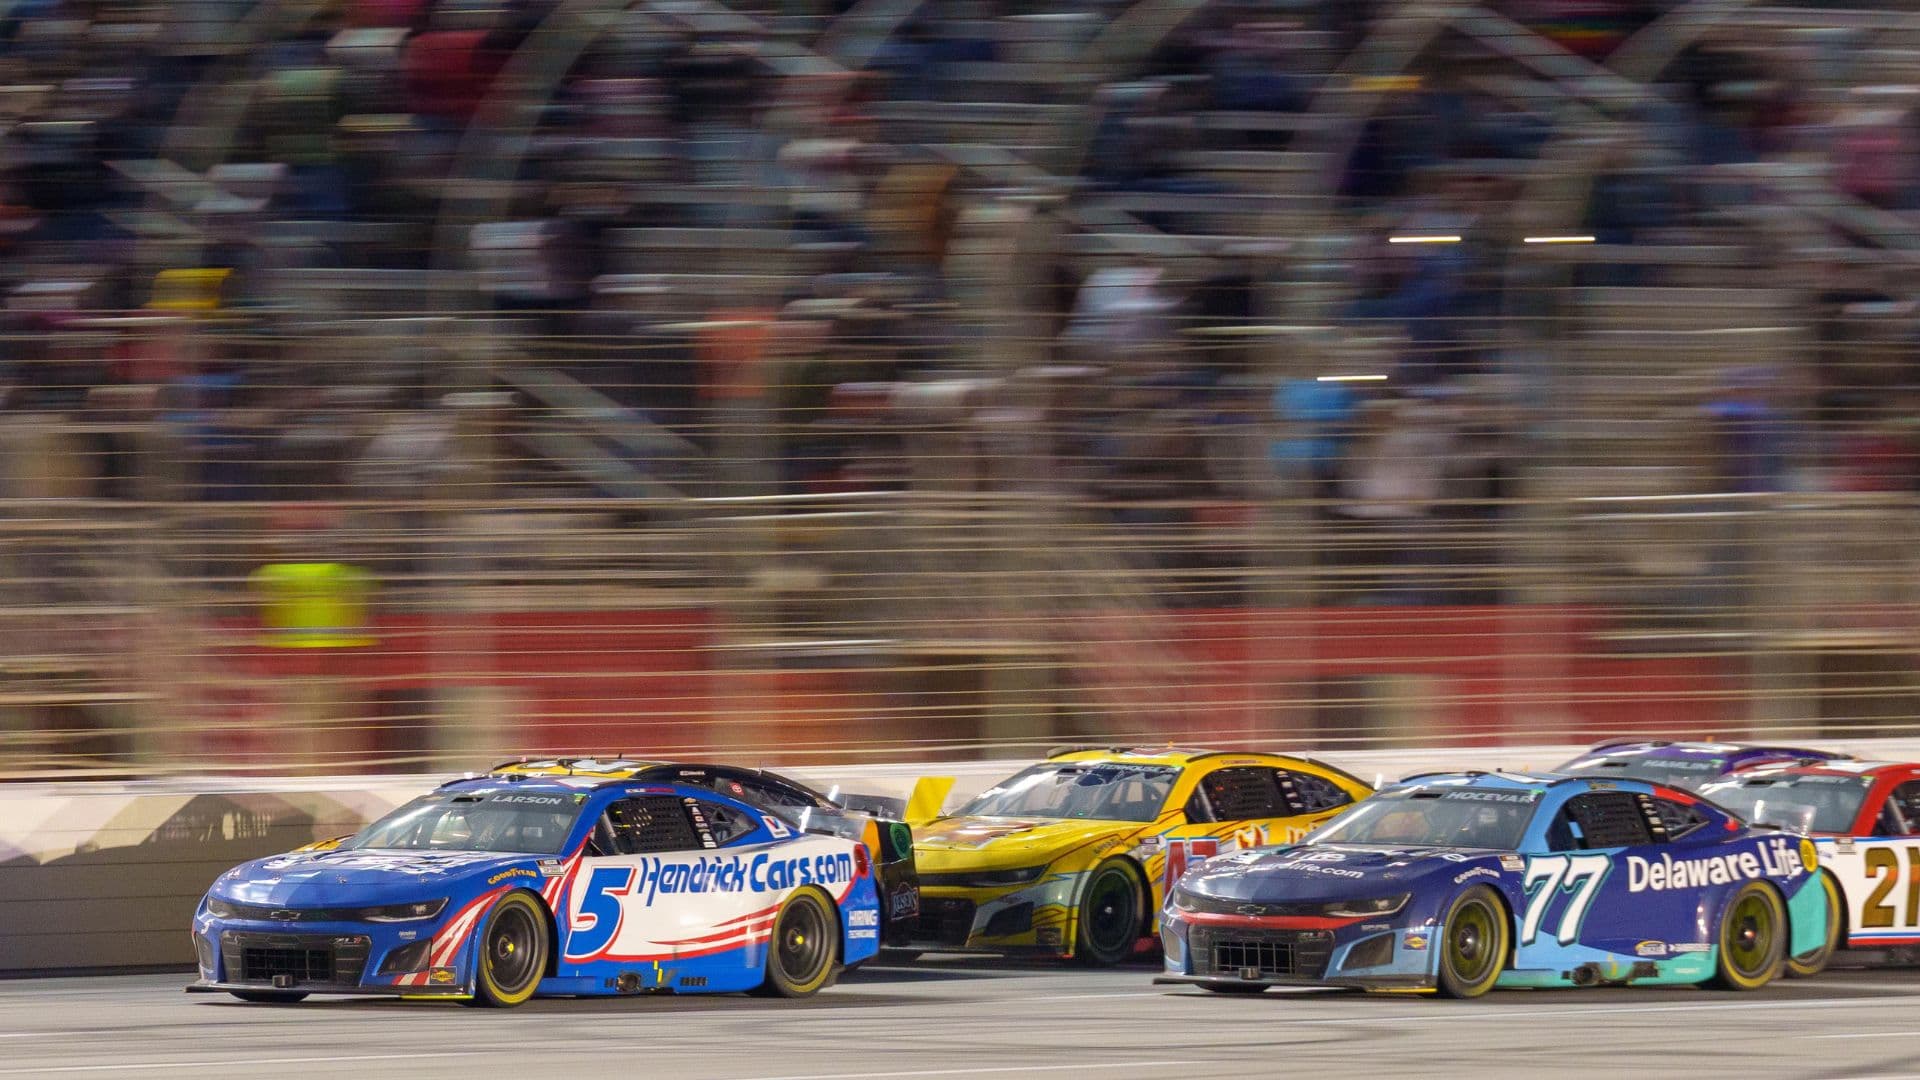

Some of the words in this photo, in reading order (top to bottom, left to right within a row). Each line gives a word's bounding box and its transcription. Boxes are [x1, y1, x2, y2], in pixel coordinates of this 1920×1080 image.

[492, 795, 562, 805] LARSON
[1447, 791, 1531, 803] HOCEVAR
[488, 867, 538, 885] GOODYEAR
[1626, 852, 1761, 893] Delaware
[1757, 838, 1802, 877] Life
[1862, 847, 1920, 928] 21
[564, 866, 637, 963] 5
[1521, 853, 1614, 947] 77
